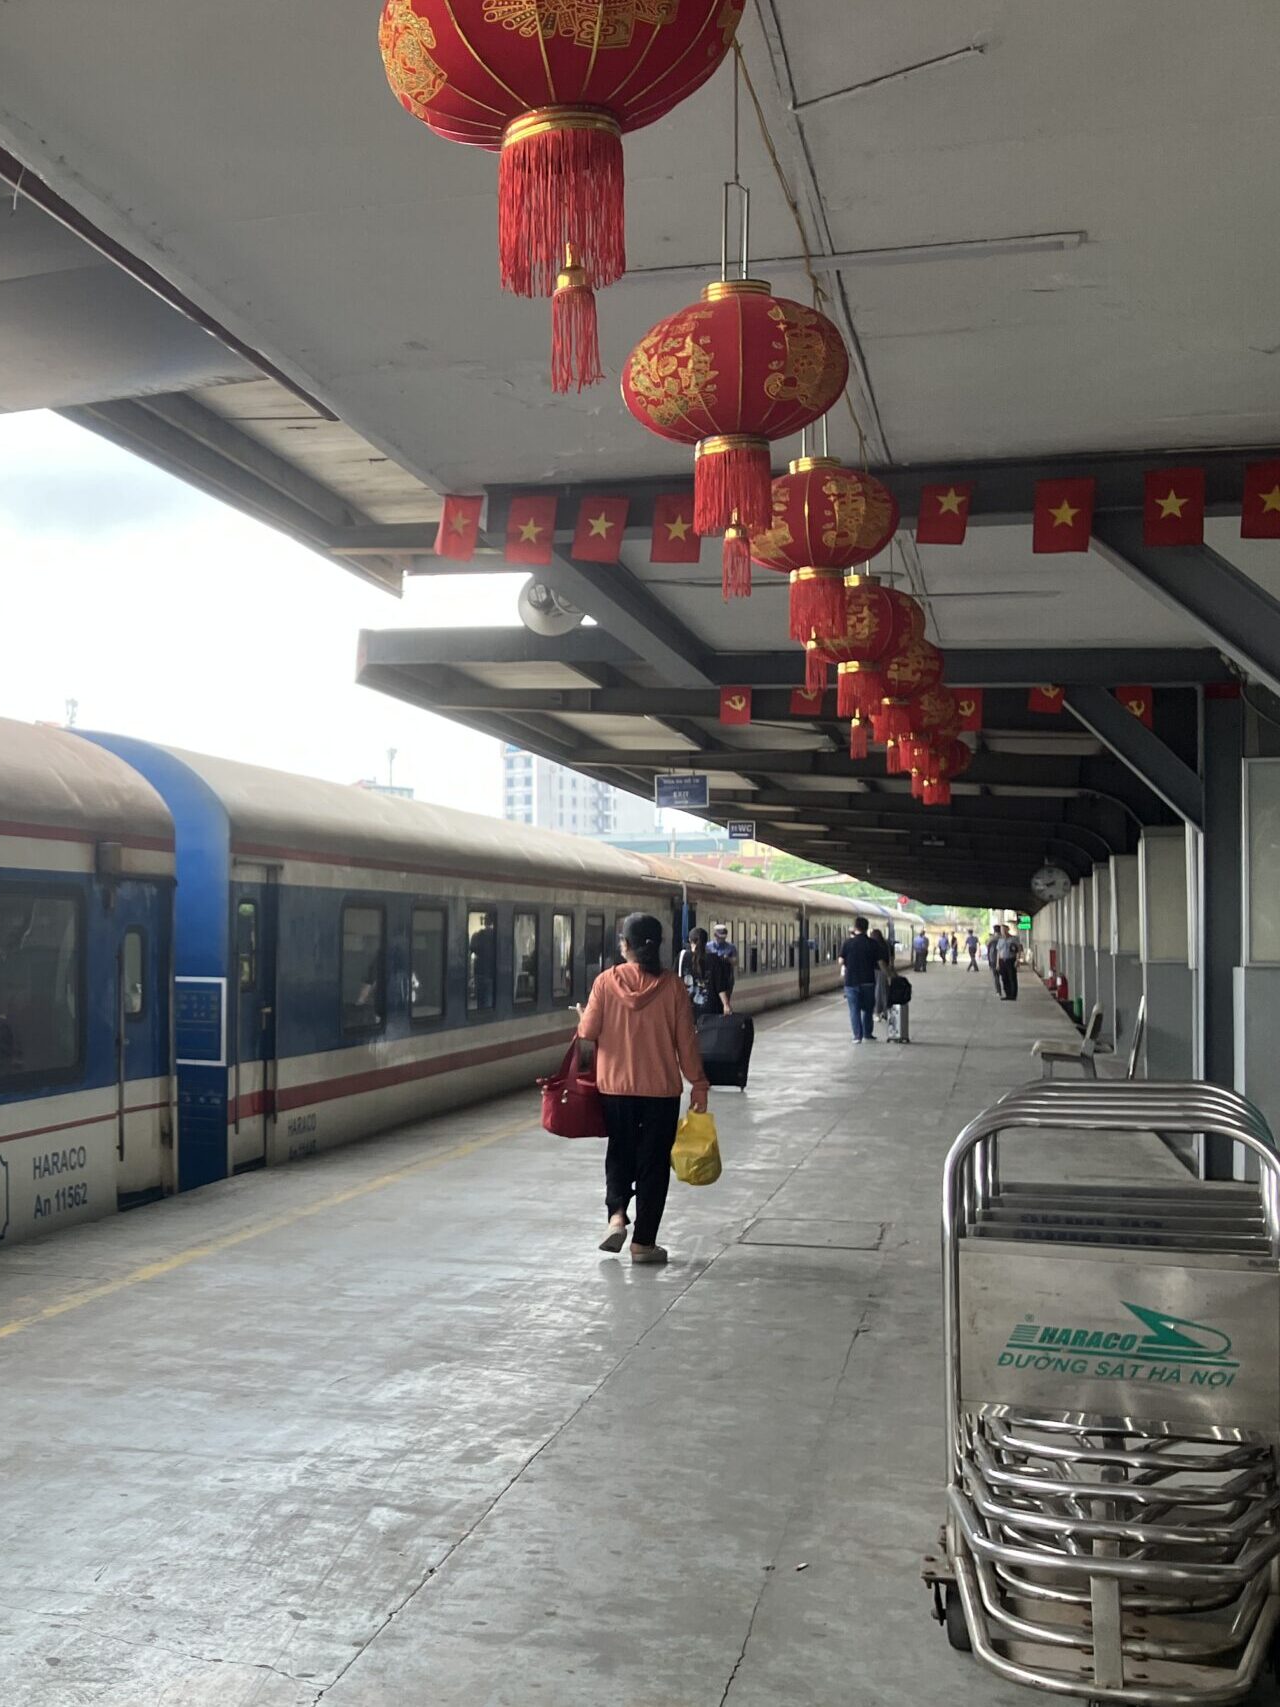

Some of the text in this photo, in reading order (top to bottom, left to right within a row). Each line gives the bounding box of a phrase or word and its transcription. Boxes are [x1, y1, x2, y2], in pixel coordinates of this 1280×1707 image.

[737, 824, 753, 832] WC
[33, 1146, 87, 1180] HARACO
[34, 1182, 88, 1219] An 11562
[1038, 1326, 1138, 1352] HARACO
